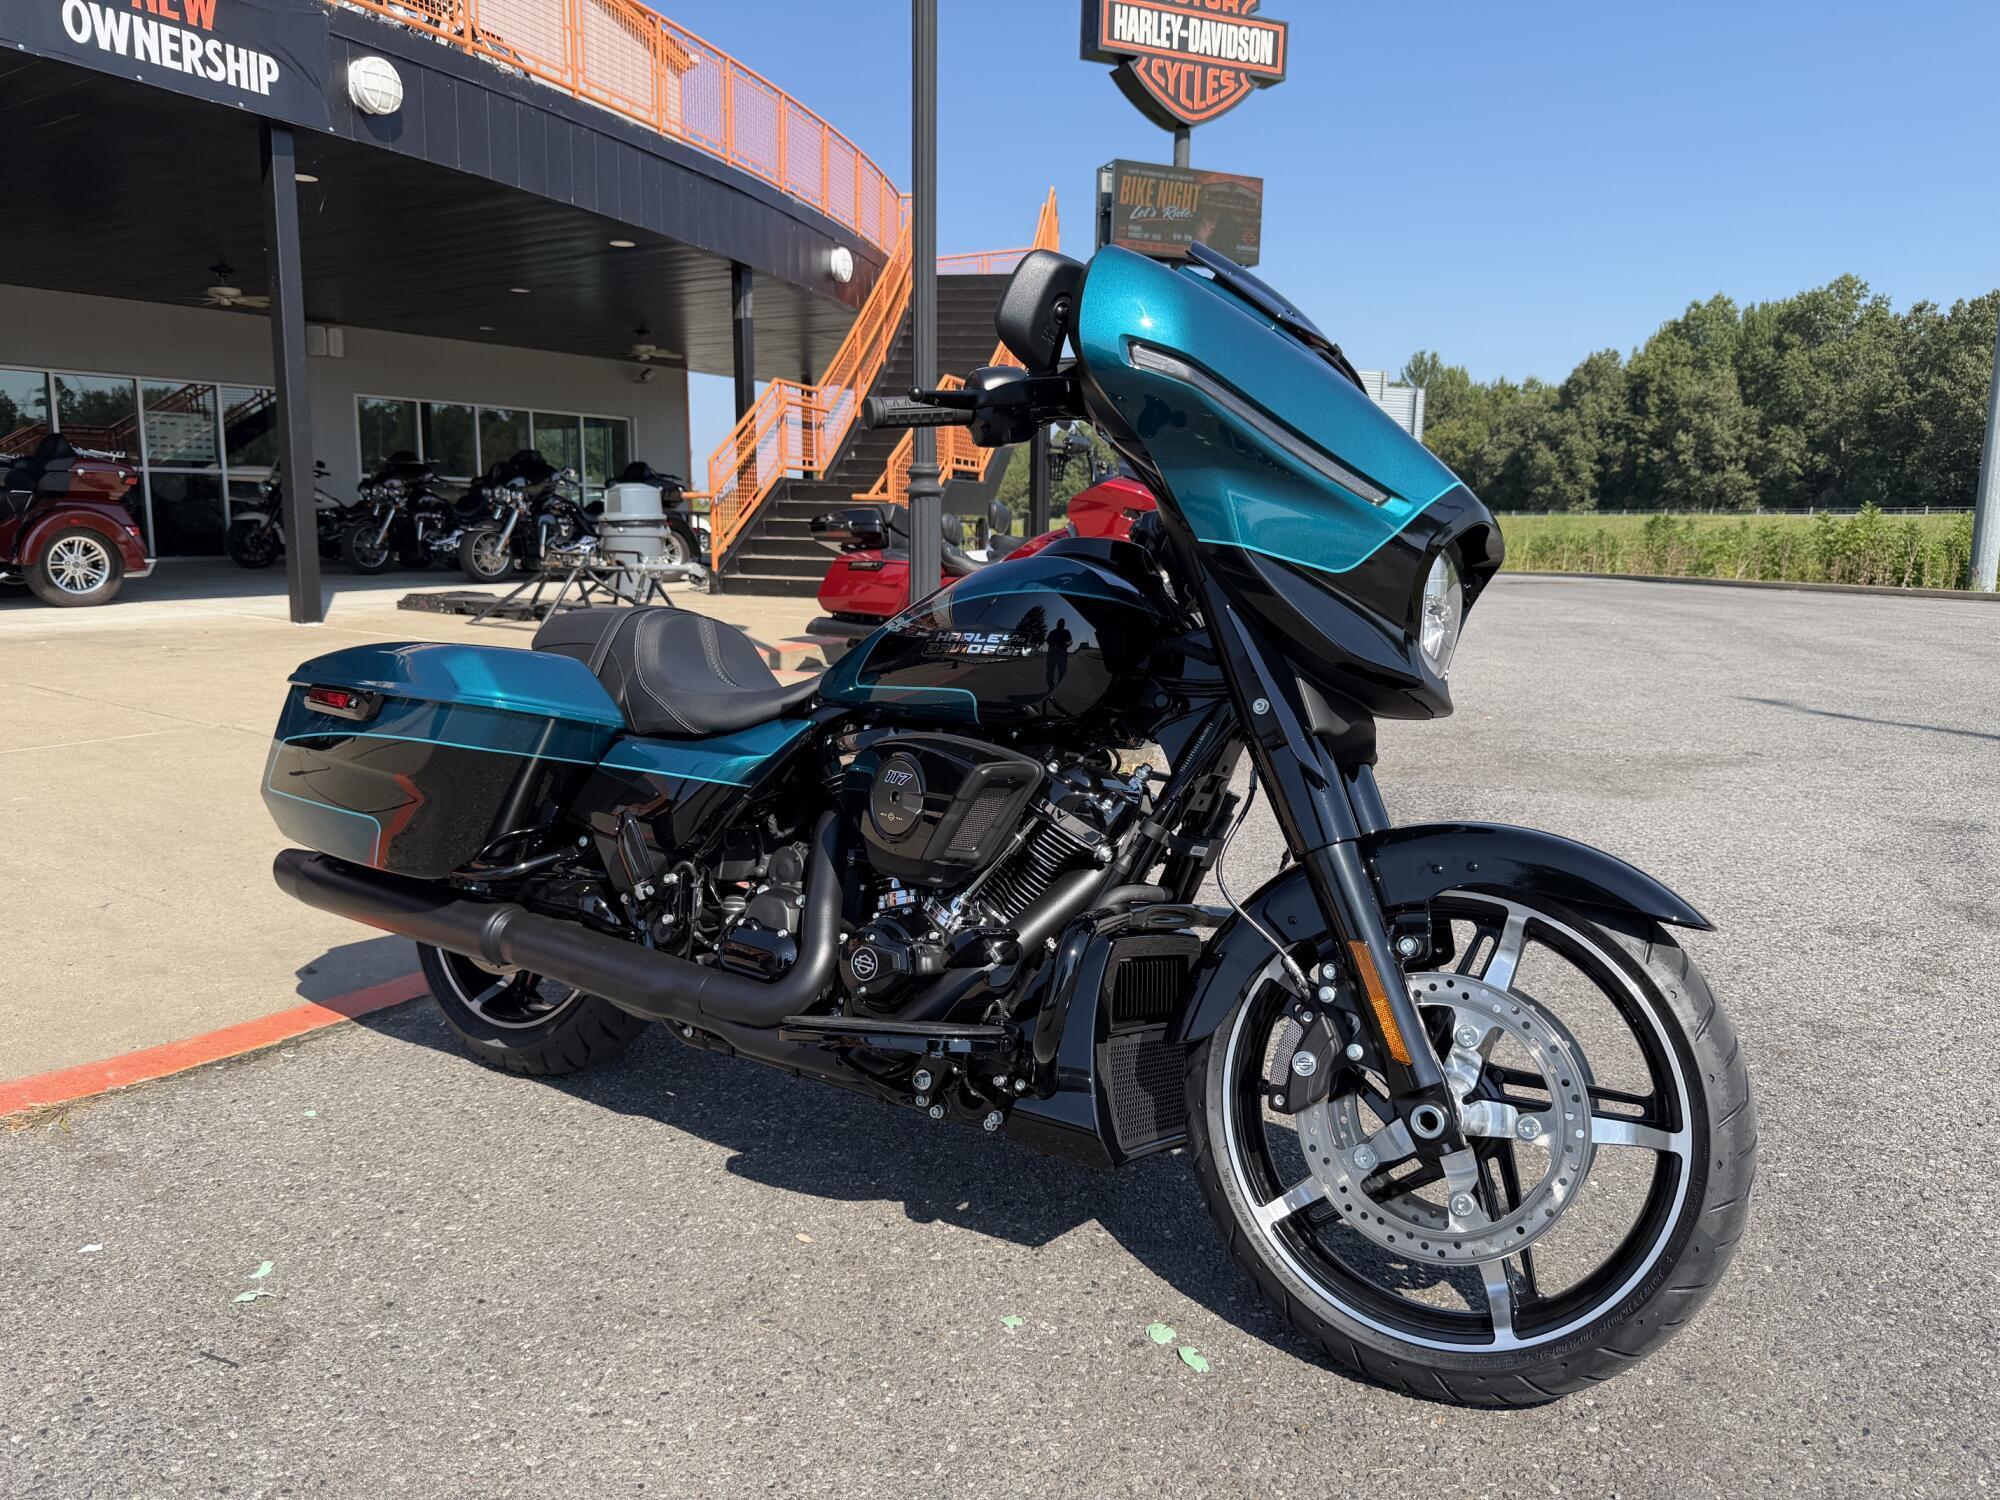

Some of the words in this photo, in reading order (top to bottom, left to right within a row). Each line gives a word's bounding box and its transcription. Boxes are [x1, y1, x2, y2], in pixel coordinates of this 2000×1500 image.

[62, 0, 280, 96] OWNERSHIP
[1113, 4, 1274, 65] HARLEY-DAVIDSON
[1151, 59, 1236, 110] CYCLES
[1119, 175, 1155, 207] BIKE
[1156, 179, 1202, 212] NIGHT
[1130, 205, 1157, 220] Let's
[885, 770, 912, 785] 117
